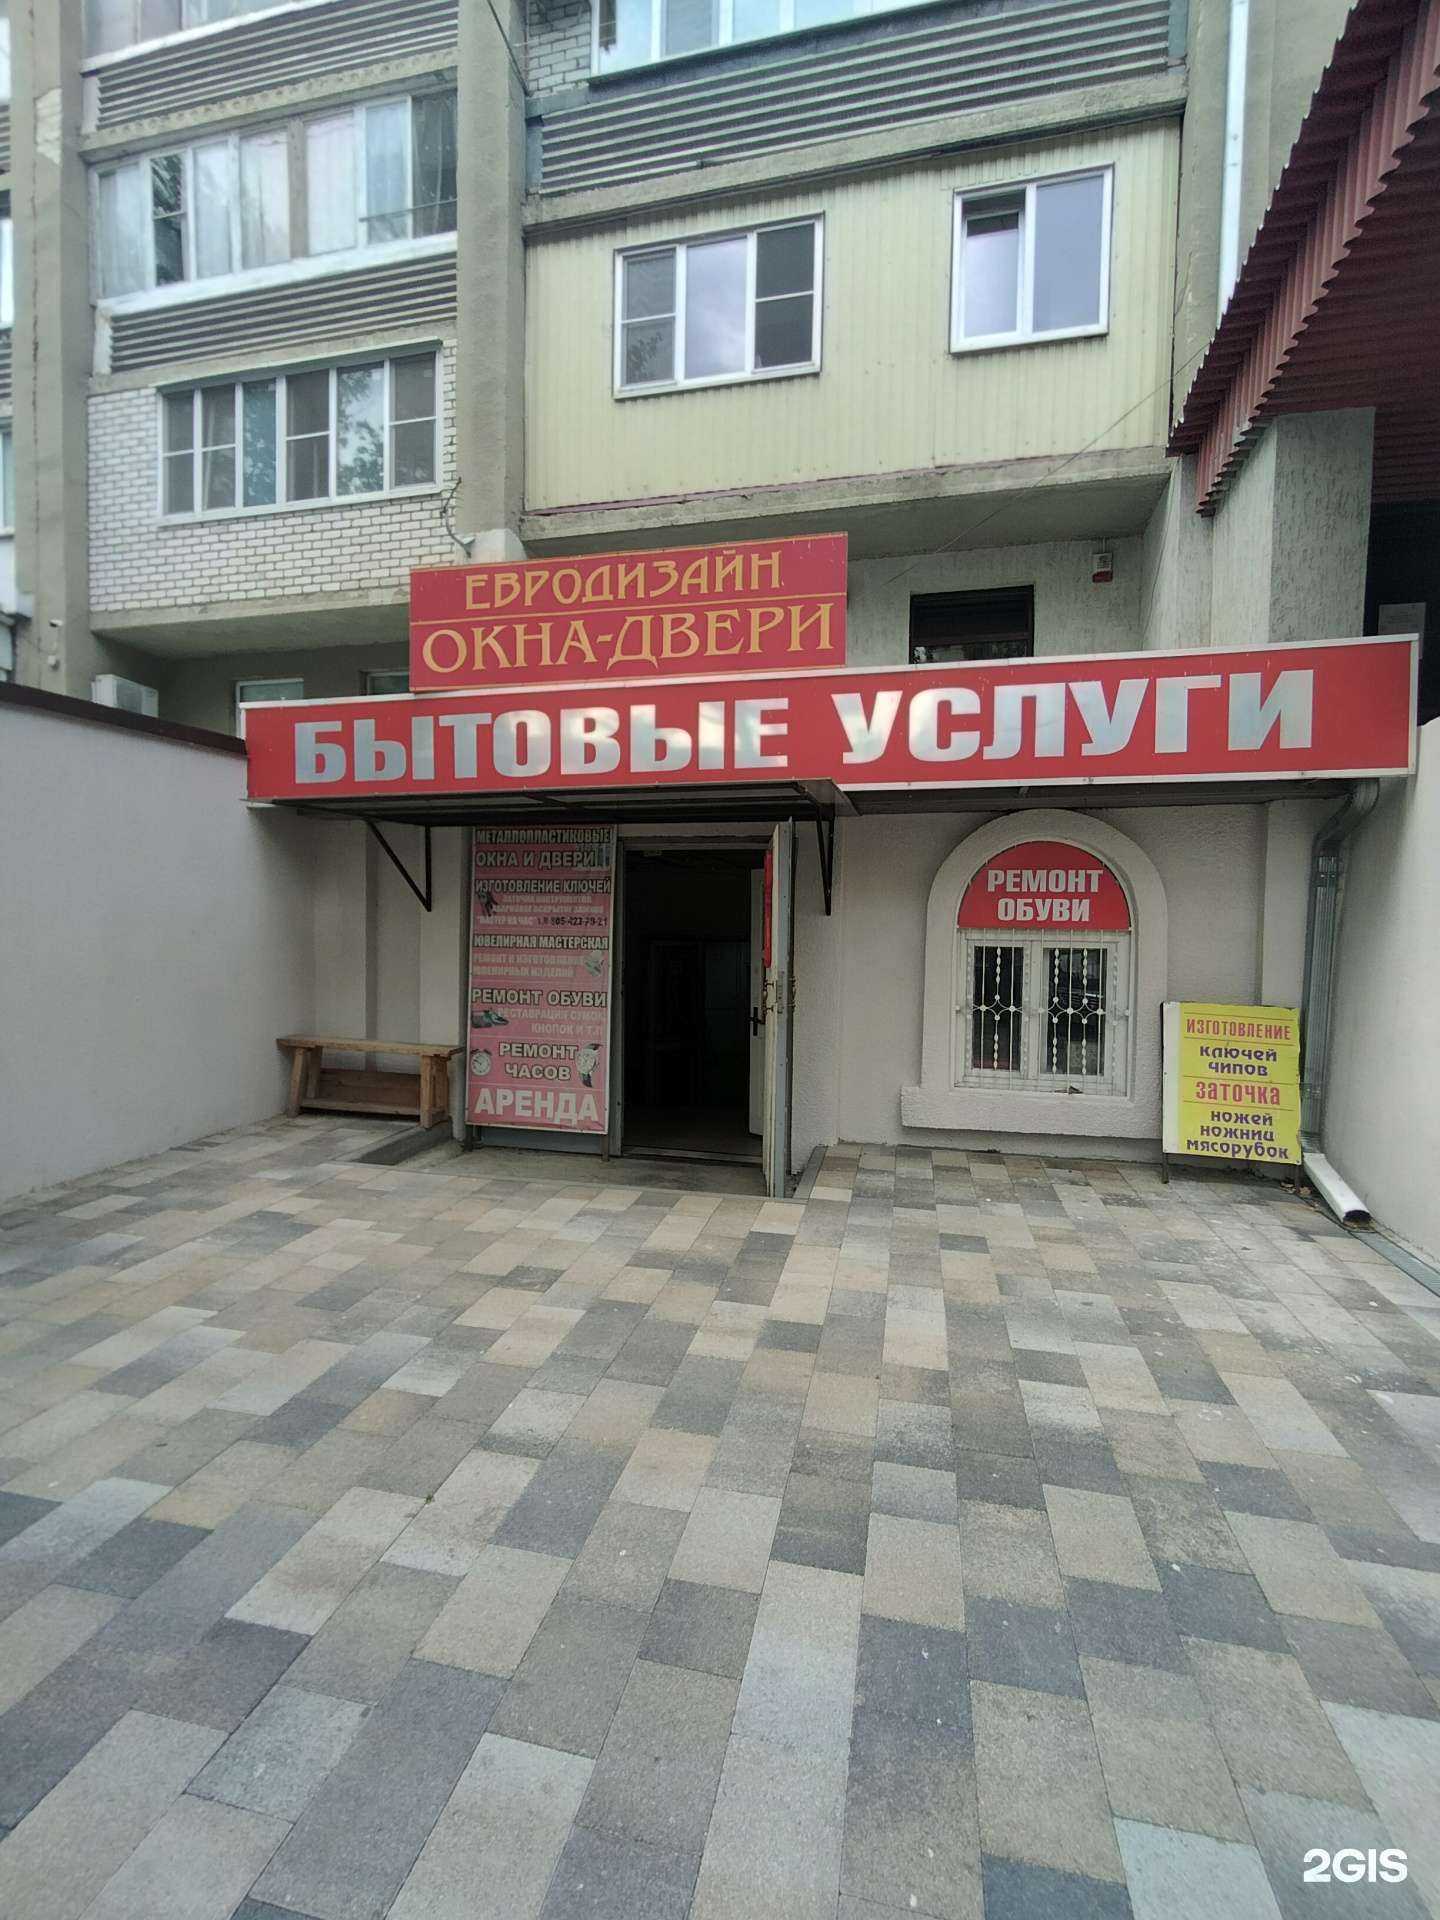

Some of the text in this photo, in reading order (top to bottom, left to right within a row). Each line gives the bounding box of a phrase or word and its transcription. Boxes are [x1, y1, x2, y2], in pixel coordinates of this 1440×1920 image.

[465, 549, 782, 611] ЕВРОДИЗАЙН
[422, 603, 835, 673] ОКНА-ДВЕРИ
[294, 669, 1314, 784] БЫТОВЫЕ УСЛУГИ
[476, 851, 594, 869] ОКНА И ДВЕРИ
[475, 877, 611, 893] ИЗГОТОВЛЕНИЕ КЛЮЧЕЙ
[986, 869, 1104, 893] РЕМОНТ
[997, 898, 1090, 922] ОБУВИ
[474, 935, 609, 949] ЮВЕЛИРНАЯ МАСТЕРСКАЯ
[472, 989, 608, 1008] РЕМОНТ ОБУВИ
[1186, 1018, 1292, 1041] ИЗГОТОВЛЕНИЕ
[499, 1042, 578, 1060] РЕМОНТ
[505, 1063, 571, 1081] ЧАСОВ
[474, 1087, 599, 1128] АРЕНДА
